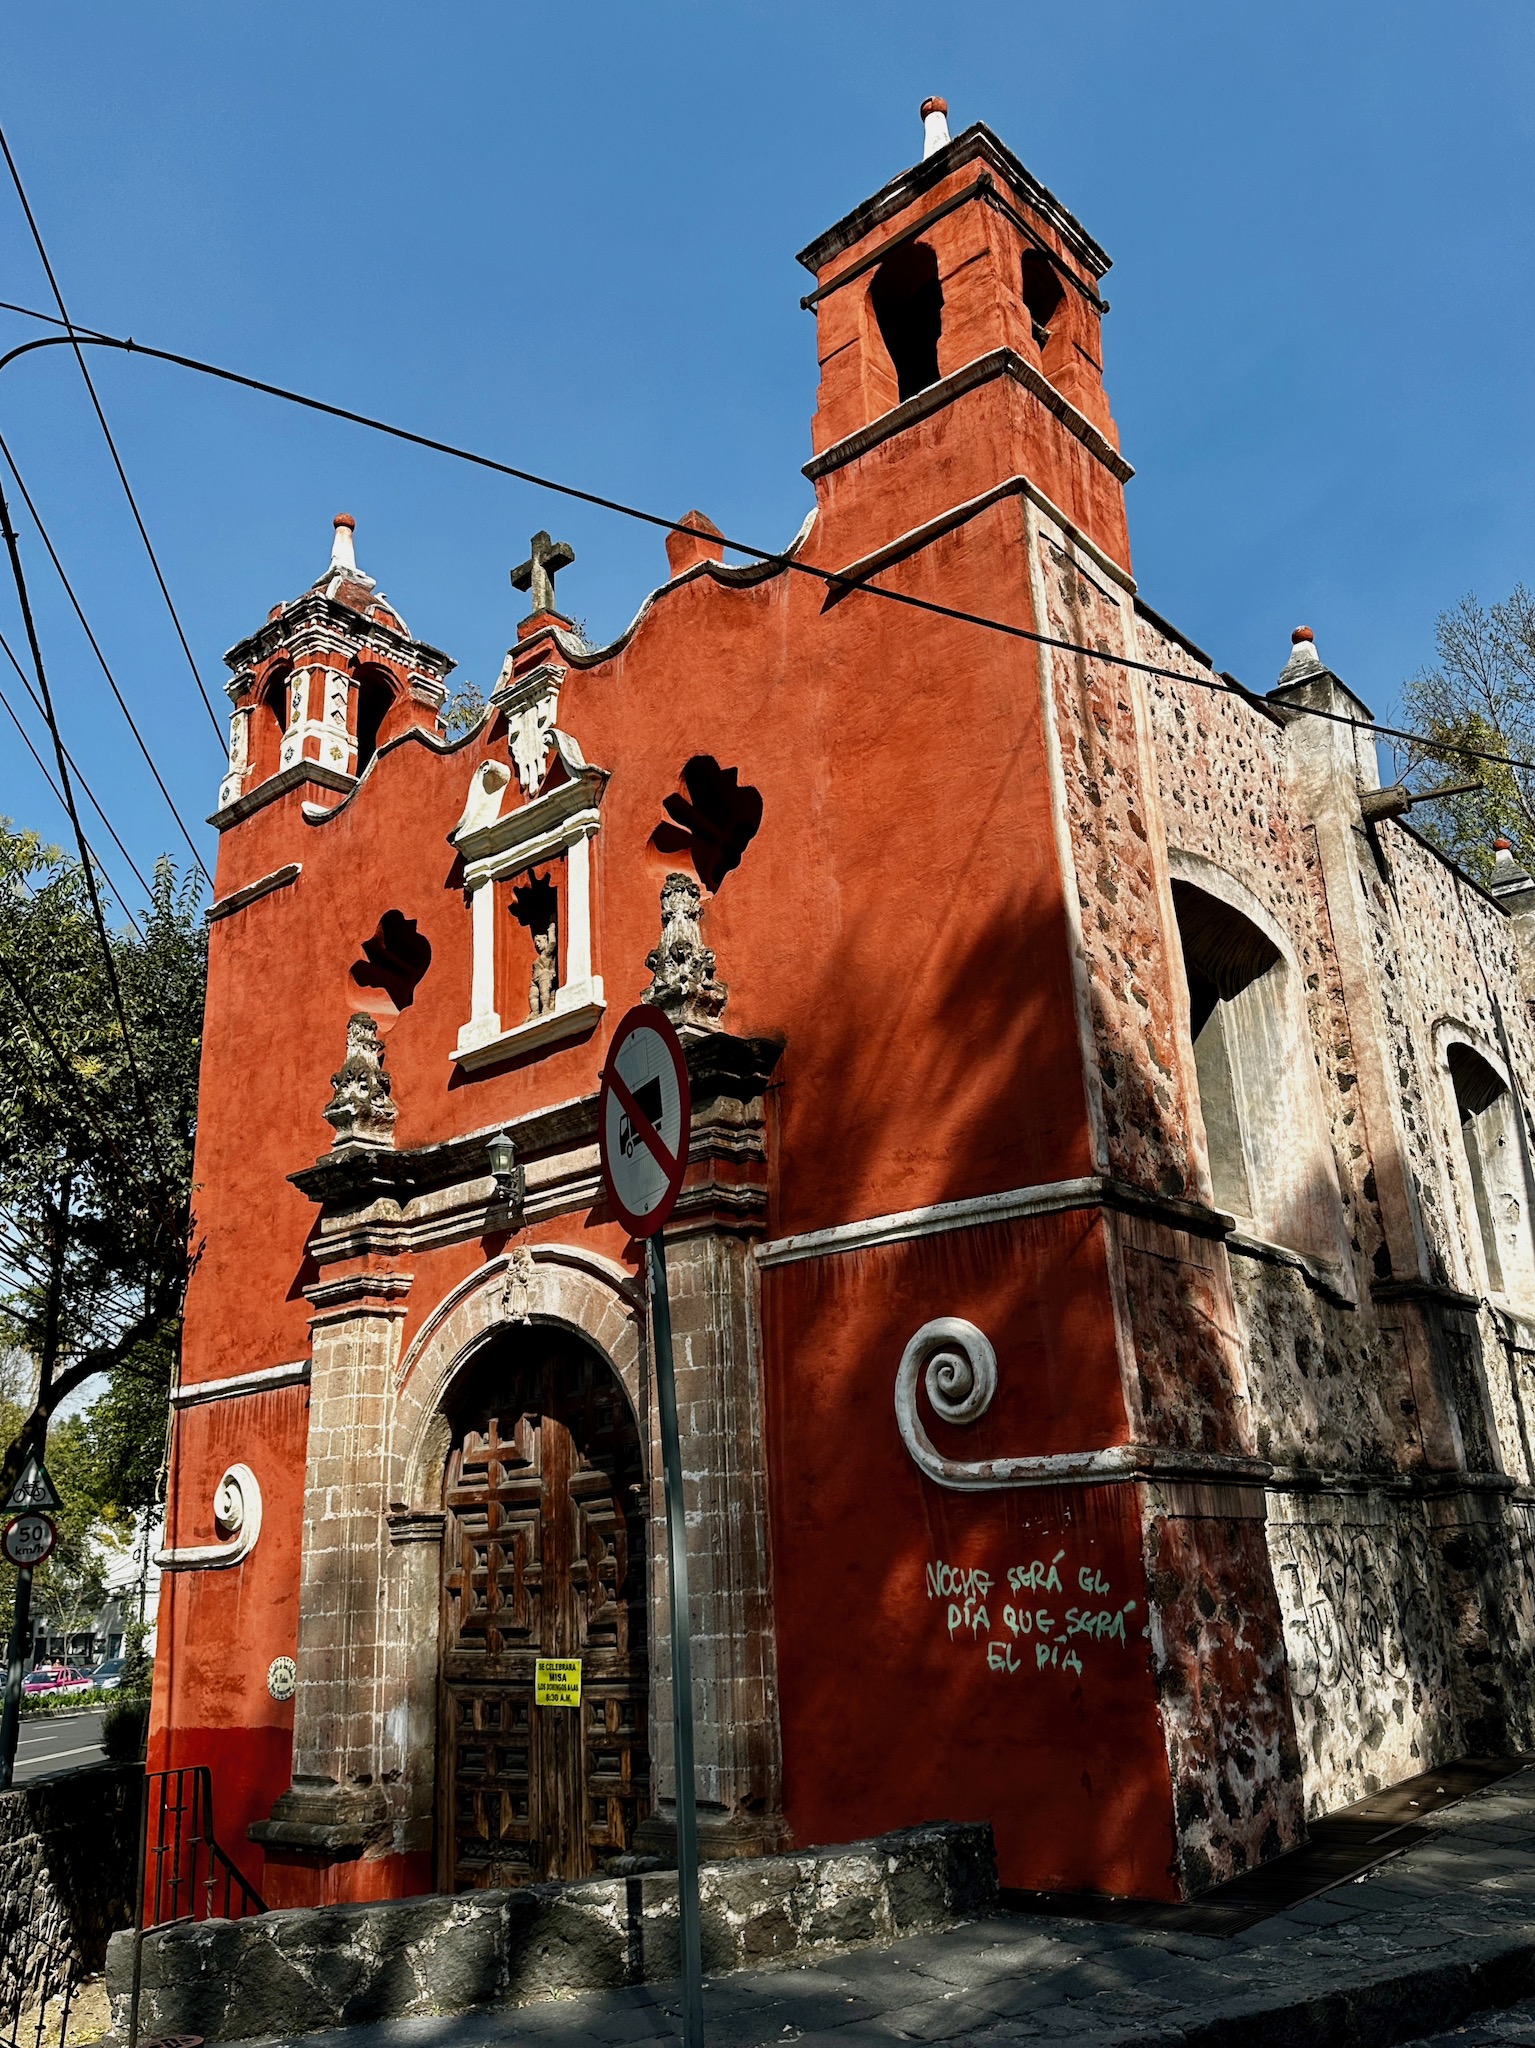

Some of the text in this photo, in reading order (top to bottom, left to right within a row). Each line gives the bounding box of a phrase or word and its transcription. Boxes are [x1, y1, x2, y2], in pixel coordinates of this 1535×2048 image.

[20, 1526, 42, 1542] 50
[15, 1544, 44, 1555] km/h
[947, 1598, 990, 1641] DÍA
[1003, 1604, 1055, 1637] QUE
[987, 1634, 1082, 1677] EL DÍA
[550, 1674, 566, 1682] MISA
